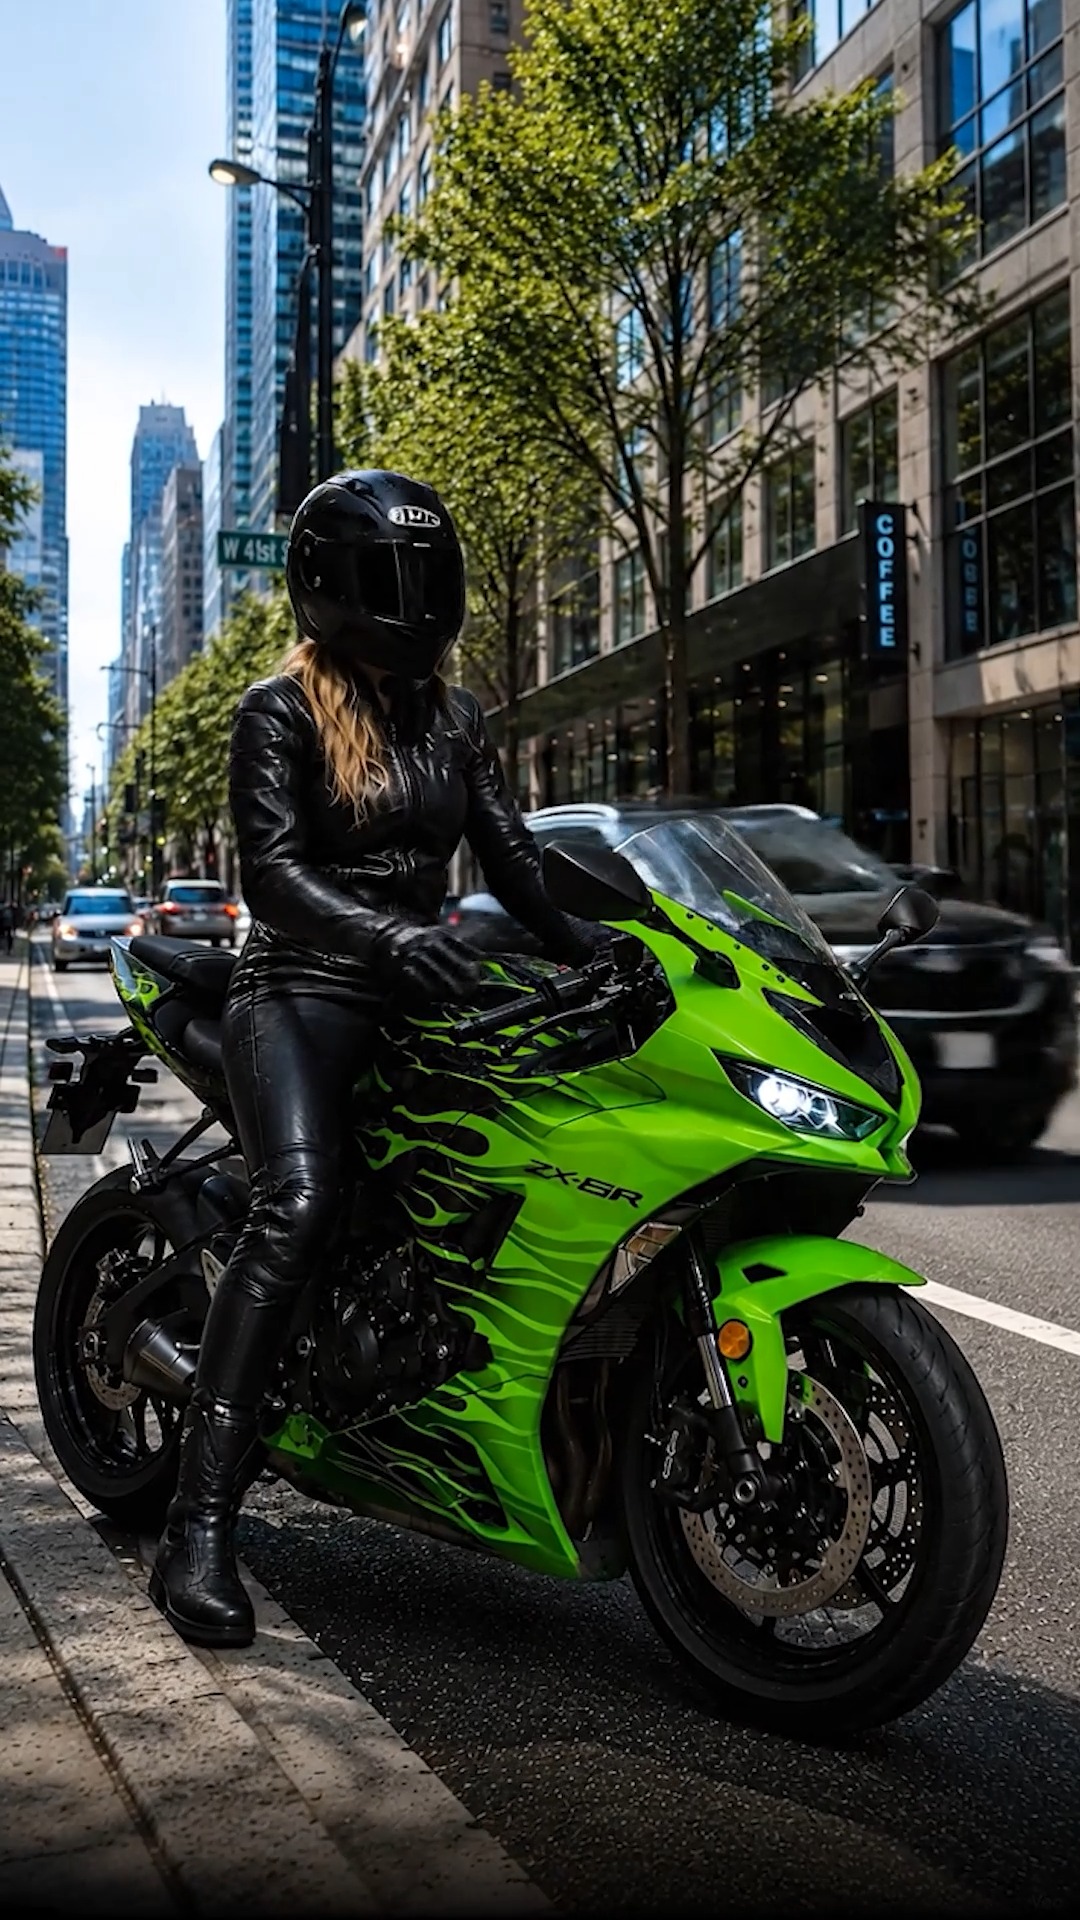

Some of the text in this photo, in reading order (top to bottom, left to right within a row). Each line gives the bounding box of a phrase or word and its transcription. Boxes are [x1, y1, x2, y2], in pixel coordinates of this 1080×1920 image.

[222, 537, 240, 561] W
[876, 513, 895, 647] COFFEE
[524, 1158, 643, 1208] ZX-6R
